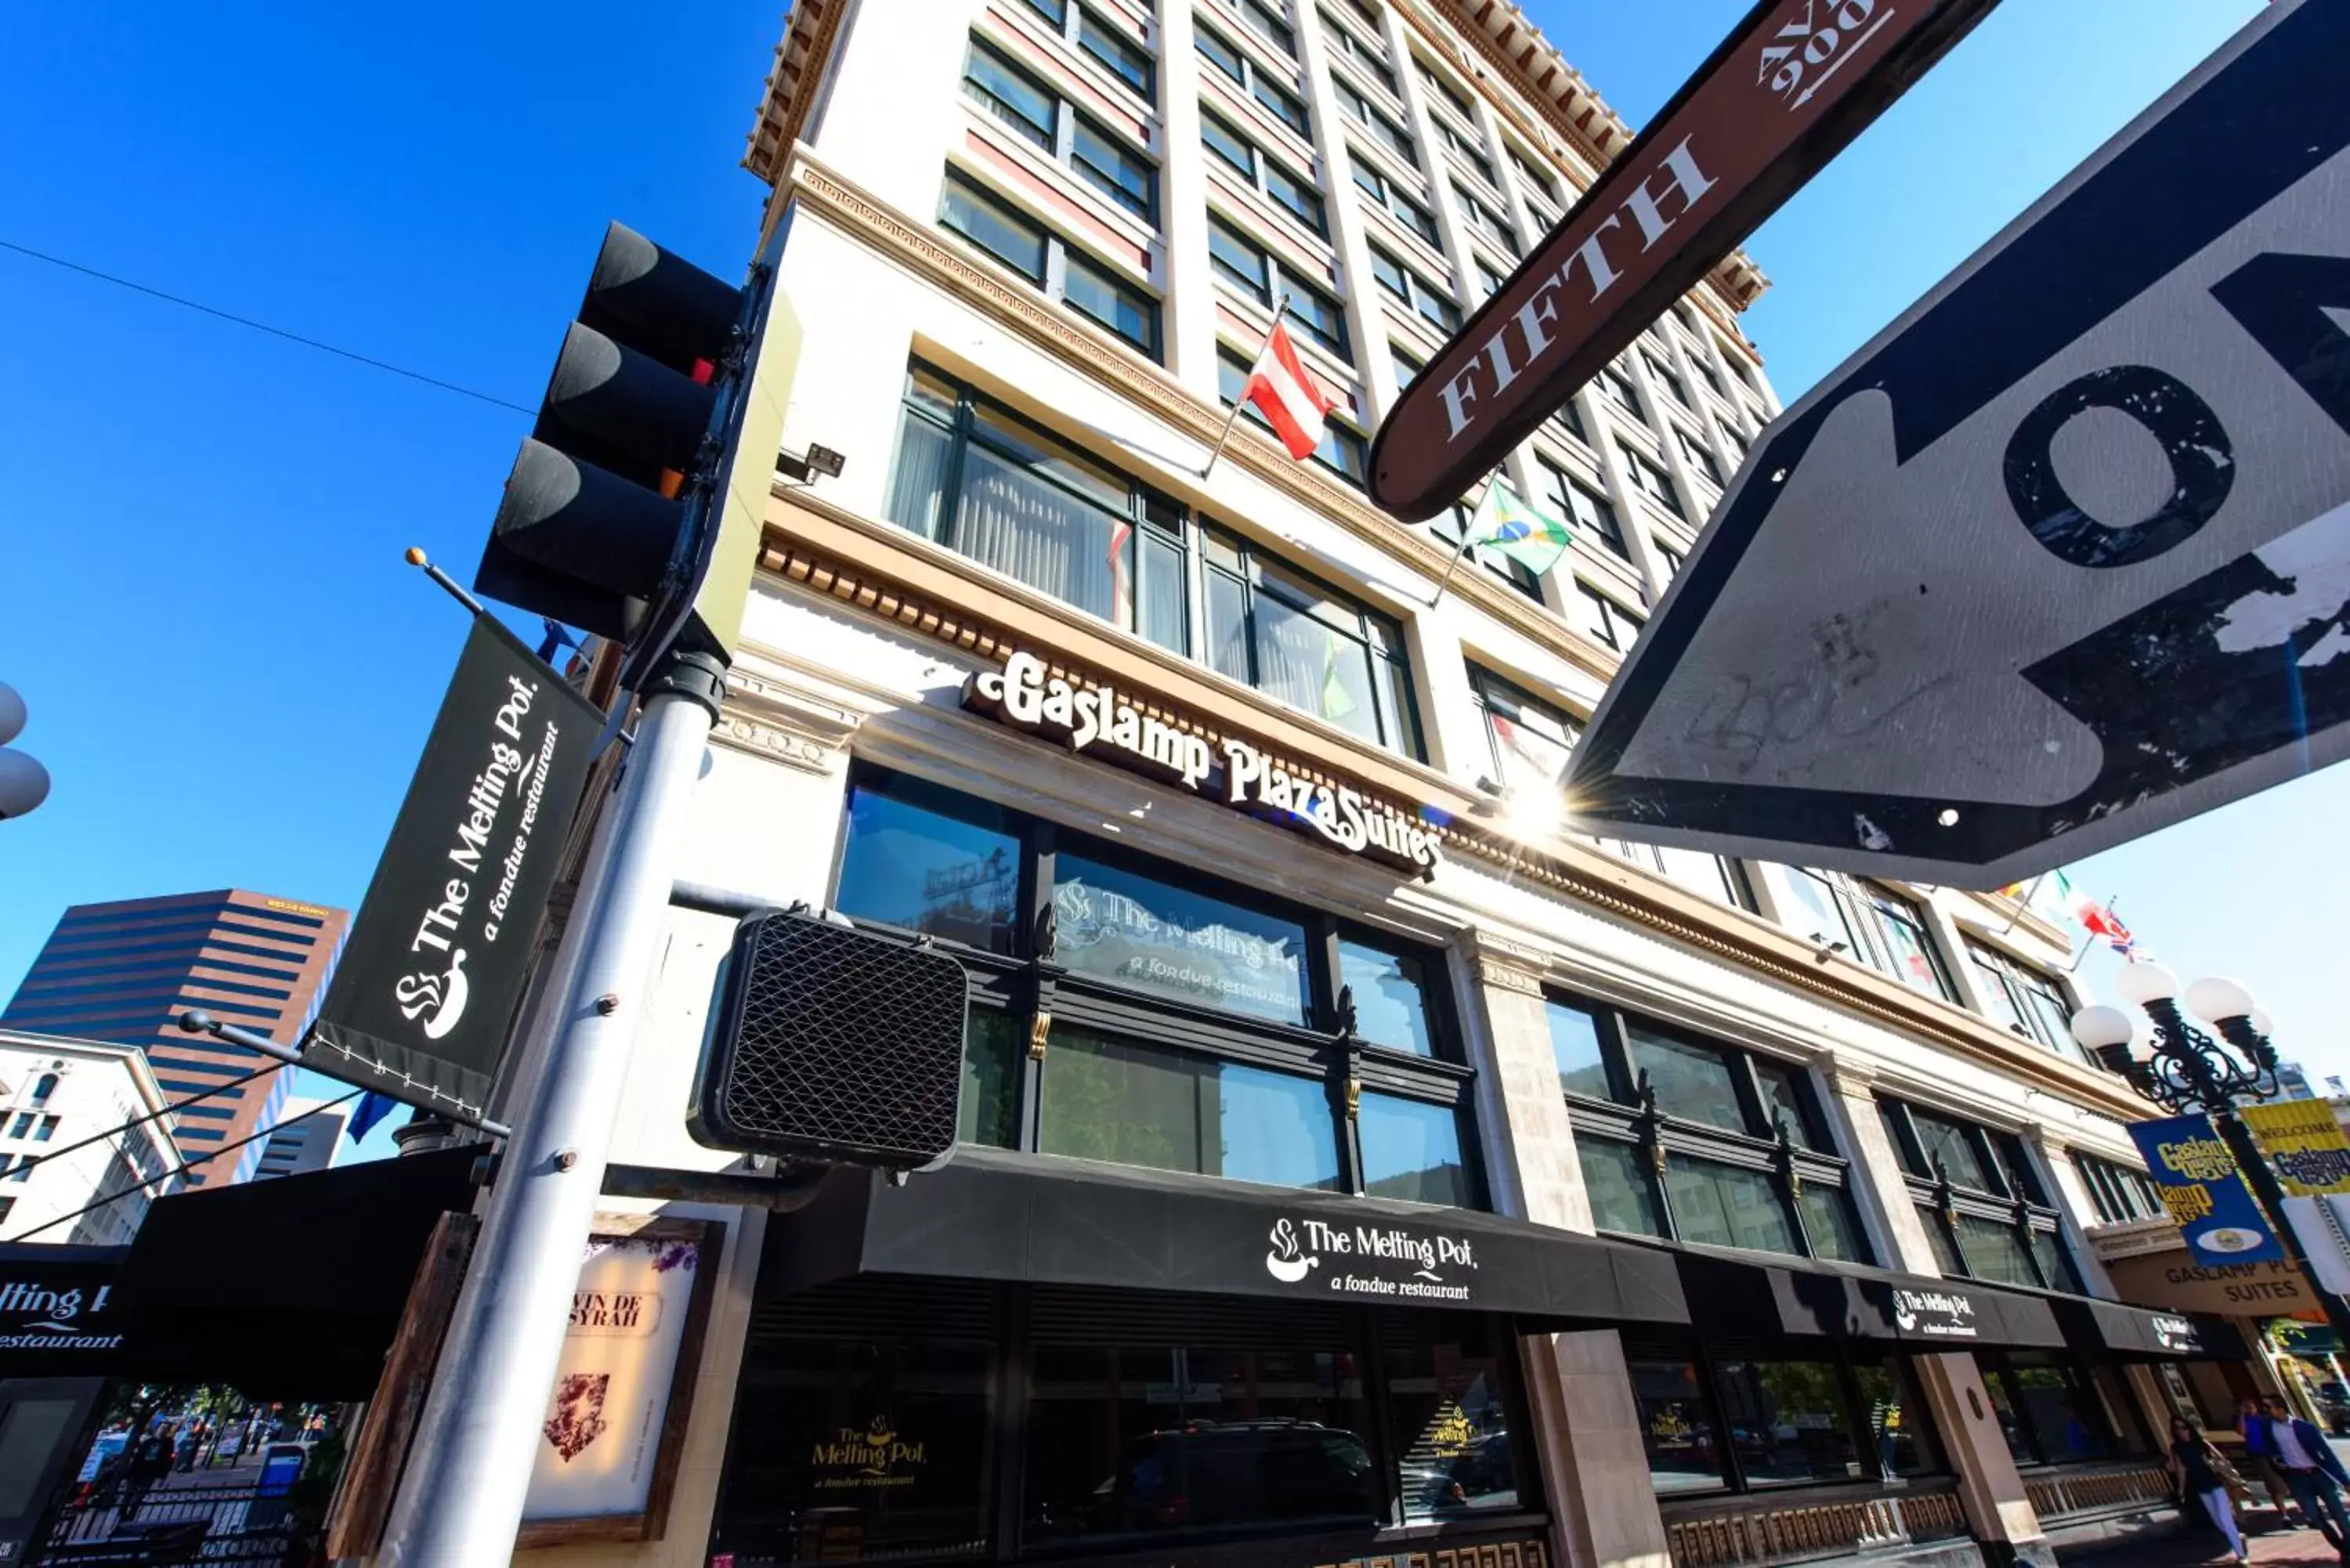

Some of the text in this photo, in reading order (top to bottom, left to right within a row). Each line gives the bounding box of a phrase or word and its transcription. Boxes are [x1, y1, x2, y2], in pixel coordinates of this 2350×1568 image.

[1756, 0, 1842, 87] AV
[1771, 0, 1875, 101] 900
[1436, 133, 1719, 443] FIFTH
[978, 652, 1443, 867] Gaslamp Plaza Suites
[412, 879, 470, 952] The
[448, 740, 522, 873] Melting
[484, 721, 559, 942] a fondue restaurant
[1101, 891, 1159, 933] The
[1147, 957, 1213, 985] fondue
[2255, 1121, 2338, 1140] WELCOME
[1303, 1219, 1351, 1253] The
[1356, 1226, 1435, 1270] Melting
[613, 1295, 642, 1311] DE
[1331, 1274, 1470, 1300] a fondue restaurant
[1901, 1290, 1925, 1310] The
[2224, 1281, 2300, 1302] SUITES
[839, 1427, 863, 1443] The
[812, 1442, 887, 1469] Melting
